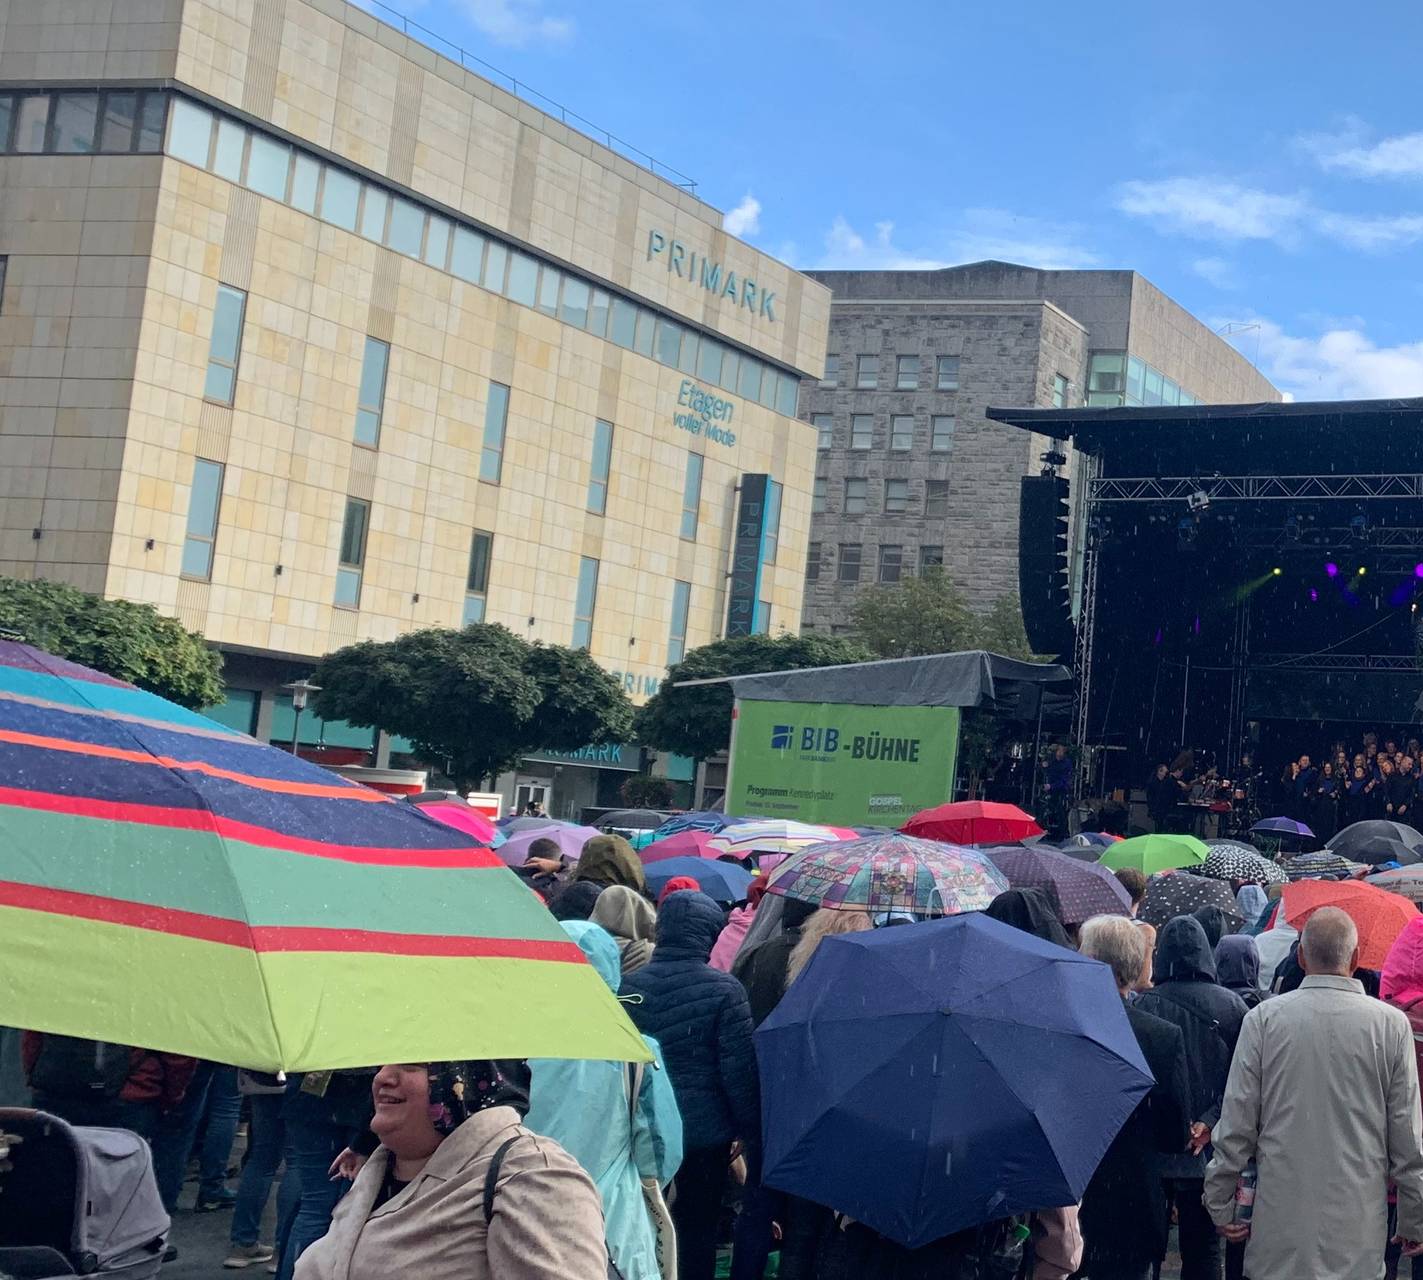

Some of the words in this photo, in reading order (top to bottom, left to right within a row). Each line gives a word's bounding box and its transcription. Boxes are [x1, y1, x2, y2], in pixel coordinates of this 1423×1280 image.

[647, 229, 777, 322] PRIMARK
[677, 379, 734, 424] Etagen
[673, 411, 704, 436] voller
[704, 420, 736, 448] Mode
[729, 502, 760, 637] PRIMARK
[801, 727, 839, 752] BIB
[747, 785, 788, 797] Programm
[869, 796, 904, 806] GOSPEL
